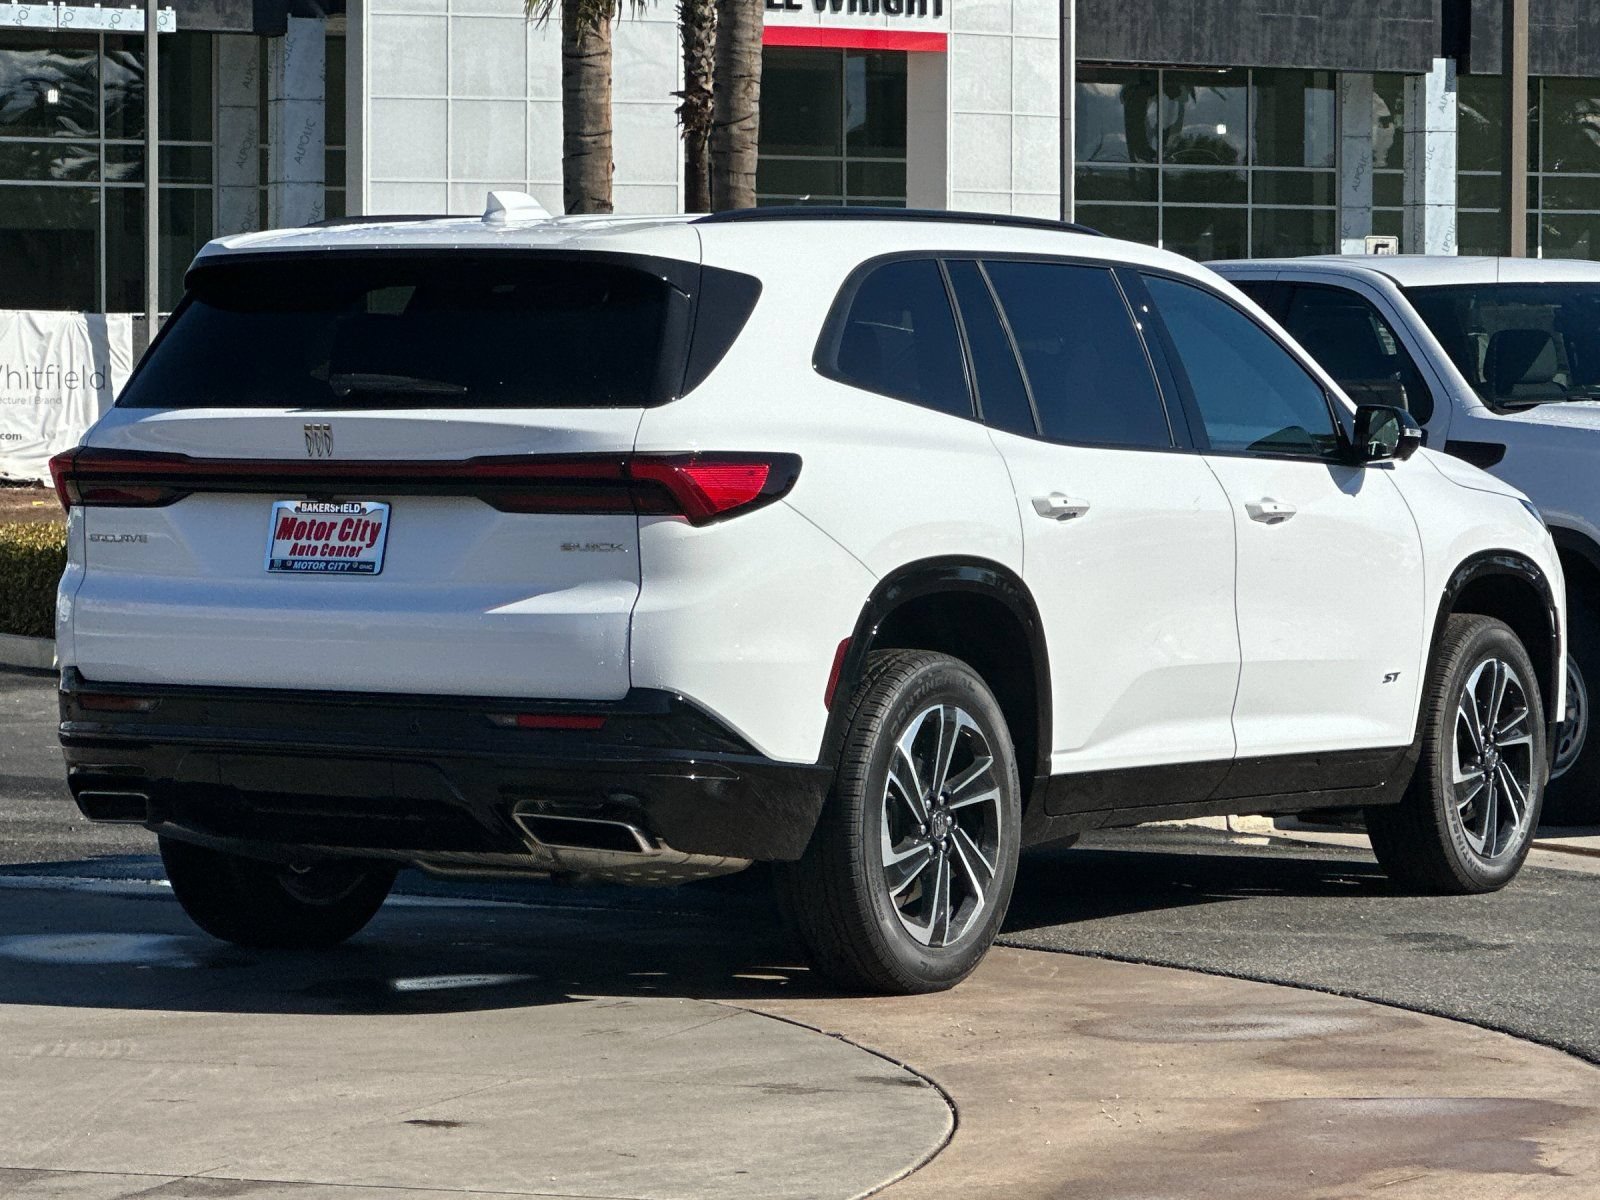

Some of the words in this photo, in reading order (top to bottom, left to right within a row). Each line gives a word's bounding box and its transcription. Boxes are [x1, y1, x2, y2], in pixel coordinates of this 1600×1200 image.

[235, 126, 257, 169] ALPOLI
[0, 364, 106, 390] hitfield
[301, 502, 361, 513] BAKERSFIELD
[276, 517, 338, 541] Motor
[338, 518, 382, 548] City
[289, 543, 318, 557] Auto
[320, 543, 363, 558] Center
[560, 542, 626, 553] BUICK
[293, 561, 326, 570] MOTOR
[327, 562, 351, 571] CITY
[1382, 671, 1401, 684] ST
